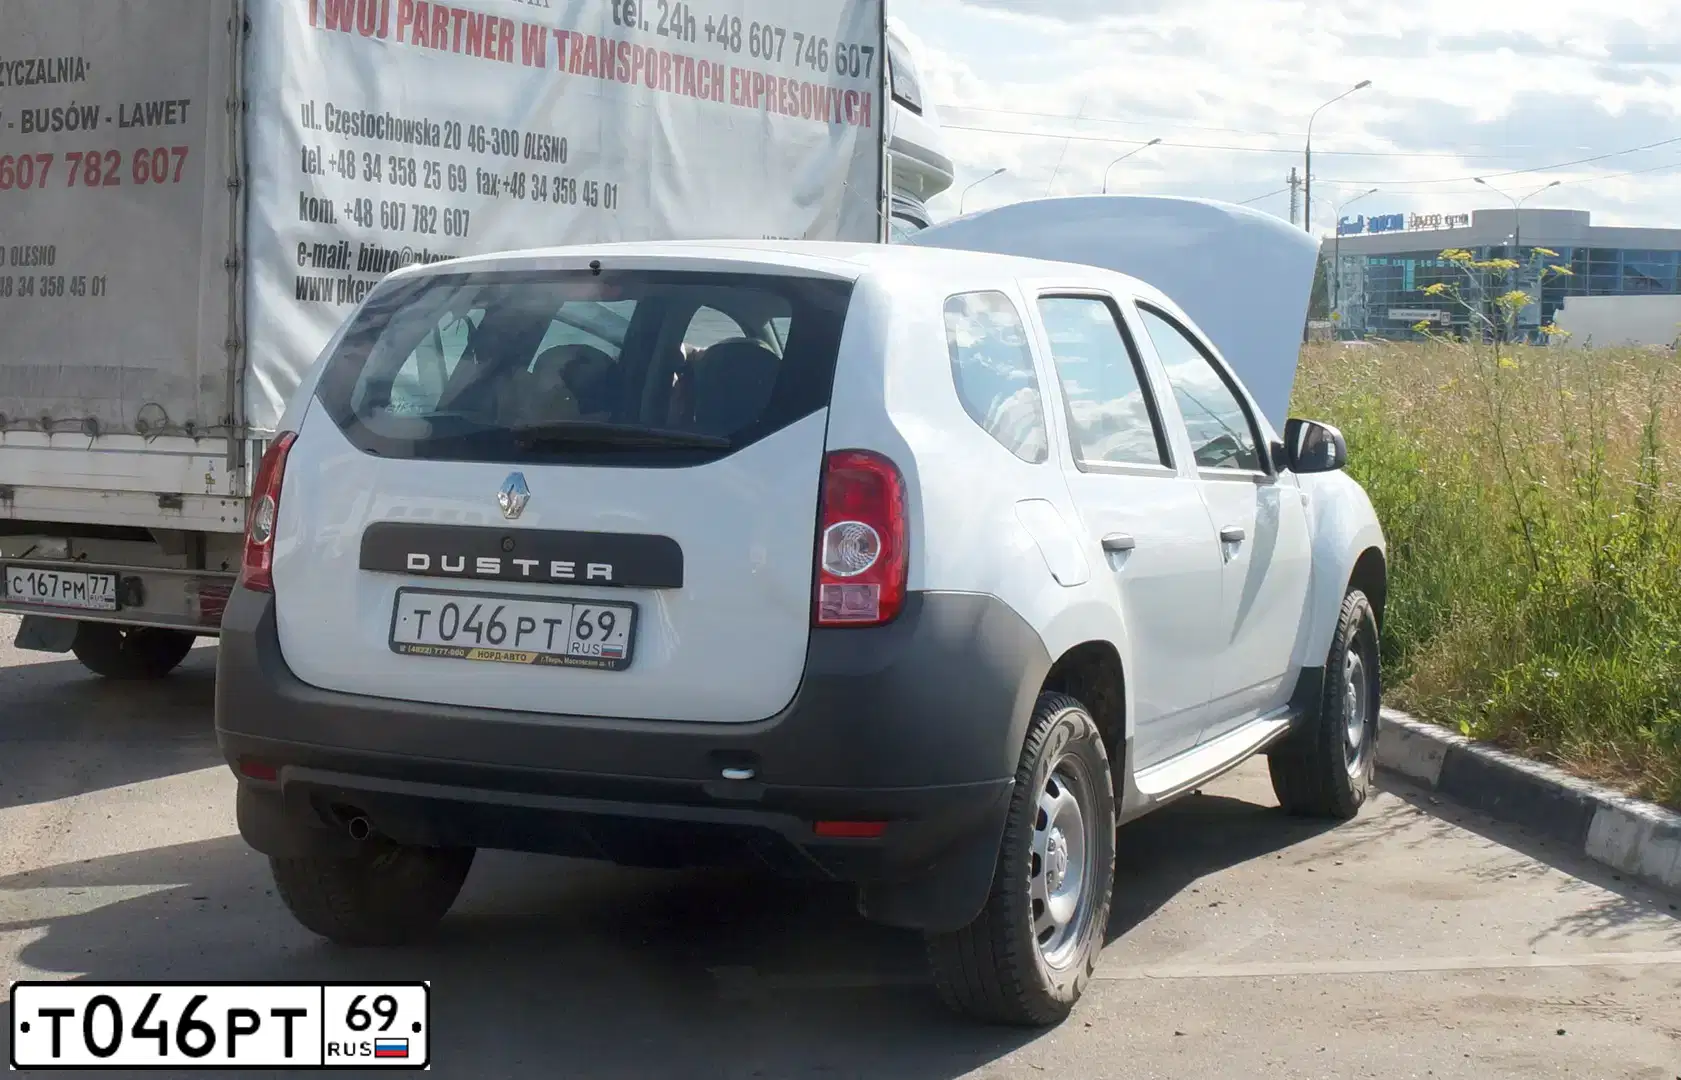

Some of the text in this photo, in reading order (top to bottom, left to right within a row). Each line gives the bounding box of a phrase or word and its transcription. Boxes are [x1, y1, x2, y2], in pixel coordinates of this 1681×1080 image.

[611, 0, 874, 78] tel. 24h +48 607 746 607
[396, 0, 515, 63] PARTNER
[521, 22, 546, 68] W
[552, 28, 725, 102] TRANSPORTACH
[730, 66, 872, 128] EXPRESOWYCH
[21, 101, 100, 133] BUSÓW
[119, 99, 190, 128] LAWET
[325, 102, 440, 146] Częstochowska
[444, 120, 461, 150] 20
[467, 124, 519, 158] 46-300
[523, 132, 568, 164] OLESNO
[0, 146, 189, 190] 607 782 607
[301, 145, 325, 176] tel.
[328, 149, 356, 181] +48
[362, 152, 382, 184] 34
[388, 155, 417, 188] 358
[423, 160, 442, 191] 25
[447, 163, 467, 193] 69
[503, 171, 526, 200] +48
[531, 173, 547, 202] 34
[552, 176, 577, 205] 358
[582, 180, 599, 207] 45
[603, 183, 618, 210] 01
[299, 191, 470, 237] kom. +48 607 782 607
[11, 245, 56, 267] OLESNO
[297, 240, 352, 271] e-mail:
[18, 276, 34, 297] 34
[40, 276, 65, 297] 358
[70, 276, 86, 297] 45
[91, 274, 107, 297] 01
[407, 553, 614, 581] DUSTER
[90, 576, 109, 595] 77
[575, 609, 616, 642] 69
[477, 651, 527, 661] НОРД-АВТО
[571, 642, 600, 655] RUS
